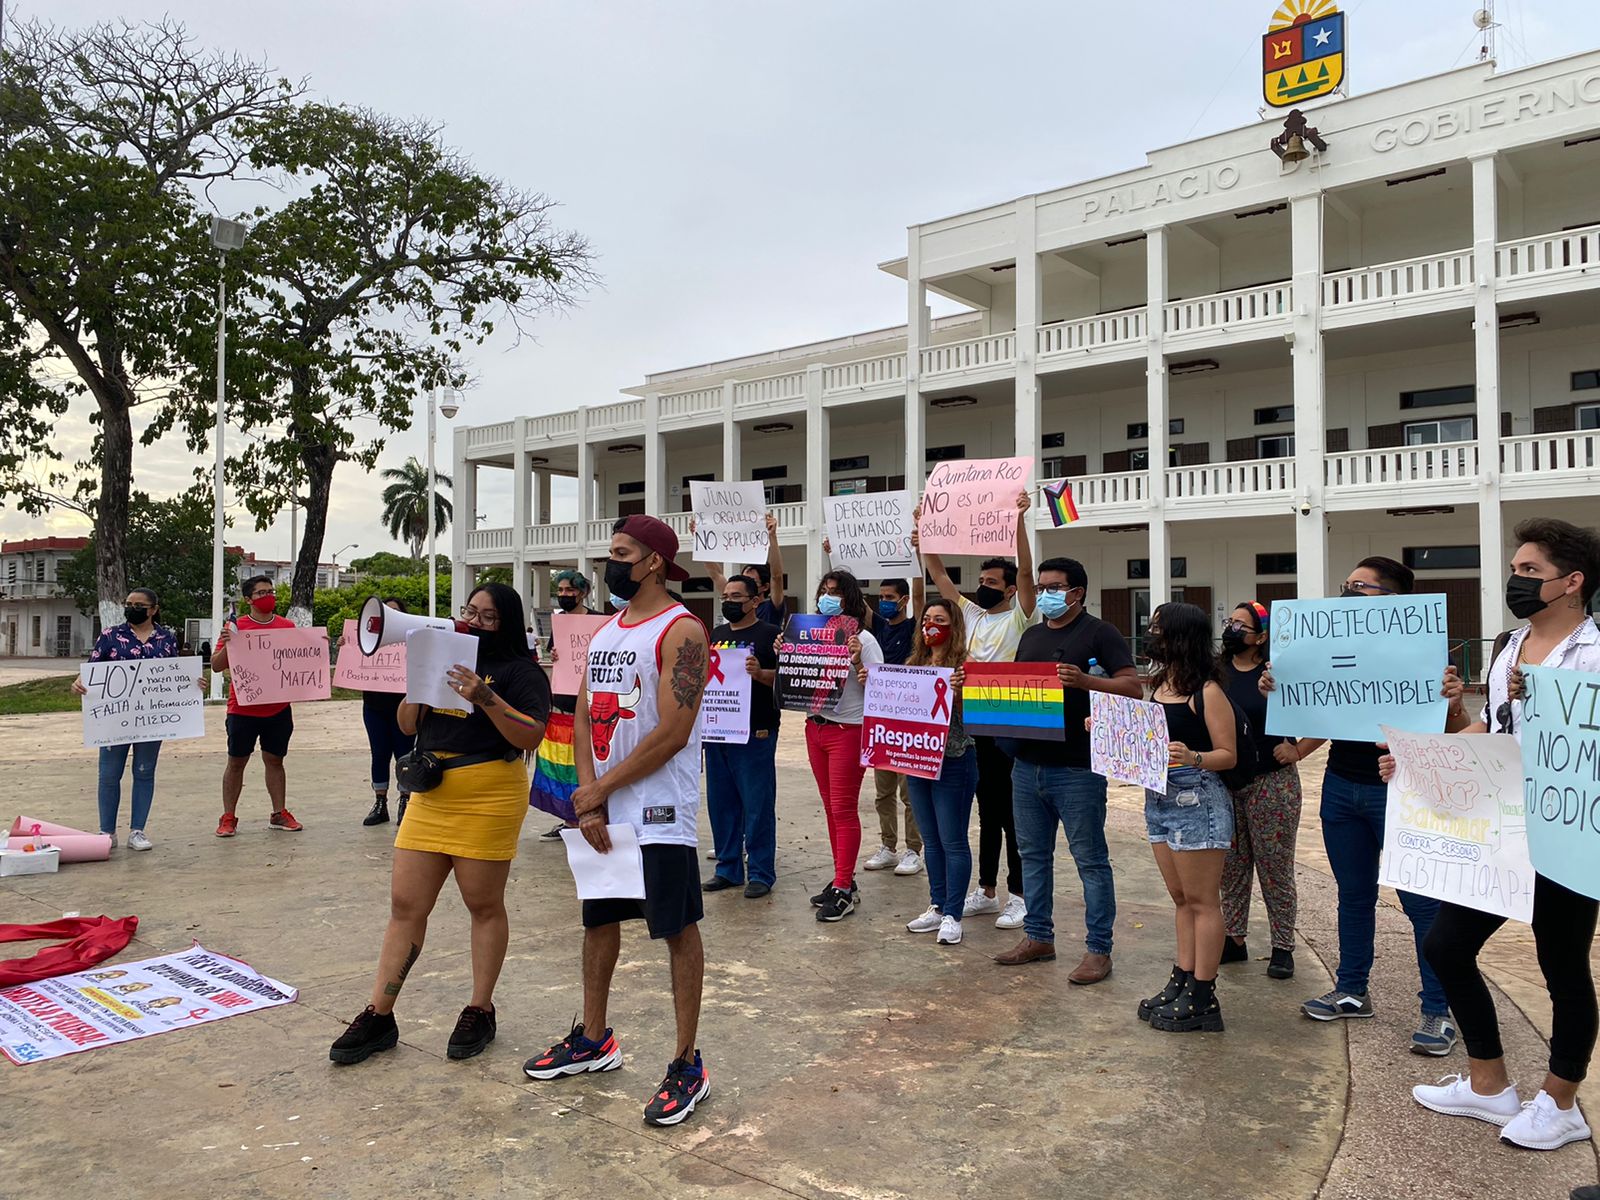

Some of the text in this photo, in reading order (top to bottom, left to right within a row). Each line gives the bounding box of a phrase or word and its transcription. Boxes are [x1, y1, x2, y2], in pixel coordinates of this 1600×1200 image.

[1082, 162, 1241, 222] PALACIO
[1369, 72, 1600, 153] GOBIERNO
[931, 462, 1022, 487] Quintana Roo
[703, 487, 743, 507] JUNIO
[923, 492, 993, 515] NO es un
[713, 510, 757, 525] ORGULLO
[834, 499, 901, 521] DERECHOS
[836, 518, 903, 539] HUMANOS
[922, 518, 957, 537] estado
[970, 525, 1015, 548] friendly
[695, 530, 769, 551] NO SEPULCRO
[839, 543, 868, 560] PARA
[1294, 602, 1446, 640] INDETECTABLE
[800, 628, 835, 640] EL VIH
[782, 643, 849, 655] NO DISCRIMINA
[150, 666, 164, 674] no
[575, 664, 582, 674] DE
[779, 655, 851, 666] NO DISCRIMINEMOS
[88, 662, 142, 699] 40%
[281, 669, 323, 688] MATA!
[778, 666, 818, 676] NOSOTROS
[177, 684, 191, 692] por
[790, 678, 838, 690] LO PADEZCA.
[869, 677, 917, 689] Una persona
[869, 691, 883, 699] con
[904, 693, 920, 703] sida
[978, 679, 1052, 709] NO HATE
[1281, 680, 1436, 708] INTRANSMISIBLE
[91, 700, 129, 718] FALTA
[880, 705, 893, 713] una
[135, 714, 181, 727] MIEDO
[869, 724, 945, 752] ¡Respeto!
[1537, 730, 1600, 783] NO M
[1401, 834, 1479, 858] CONTRA PERSONAS
